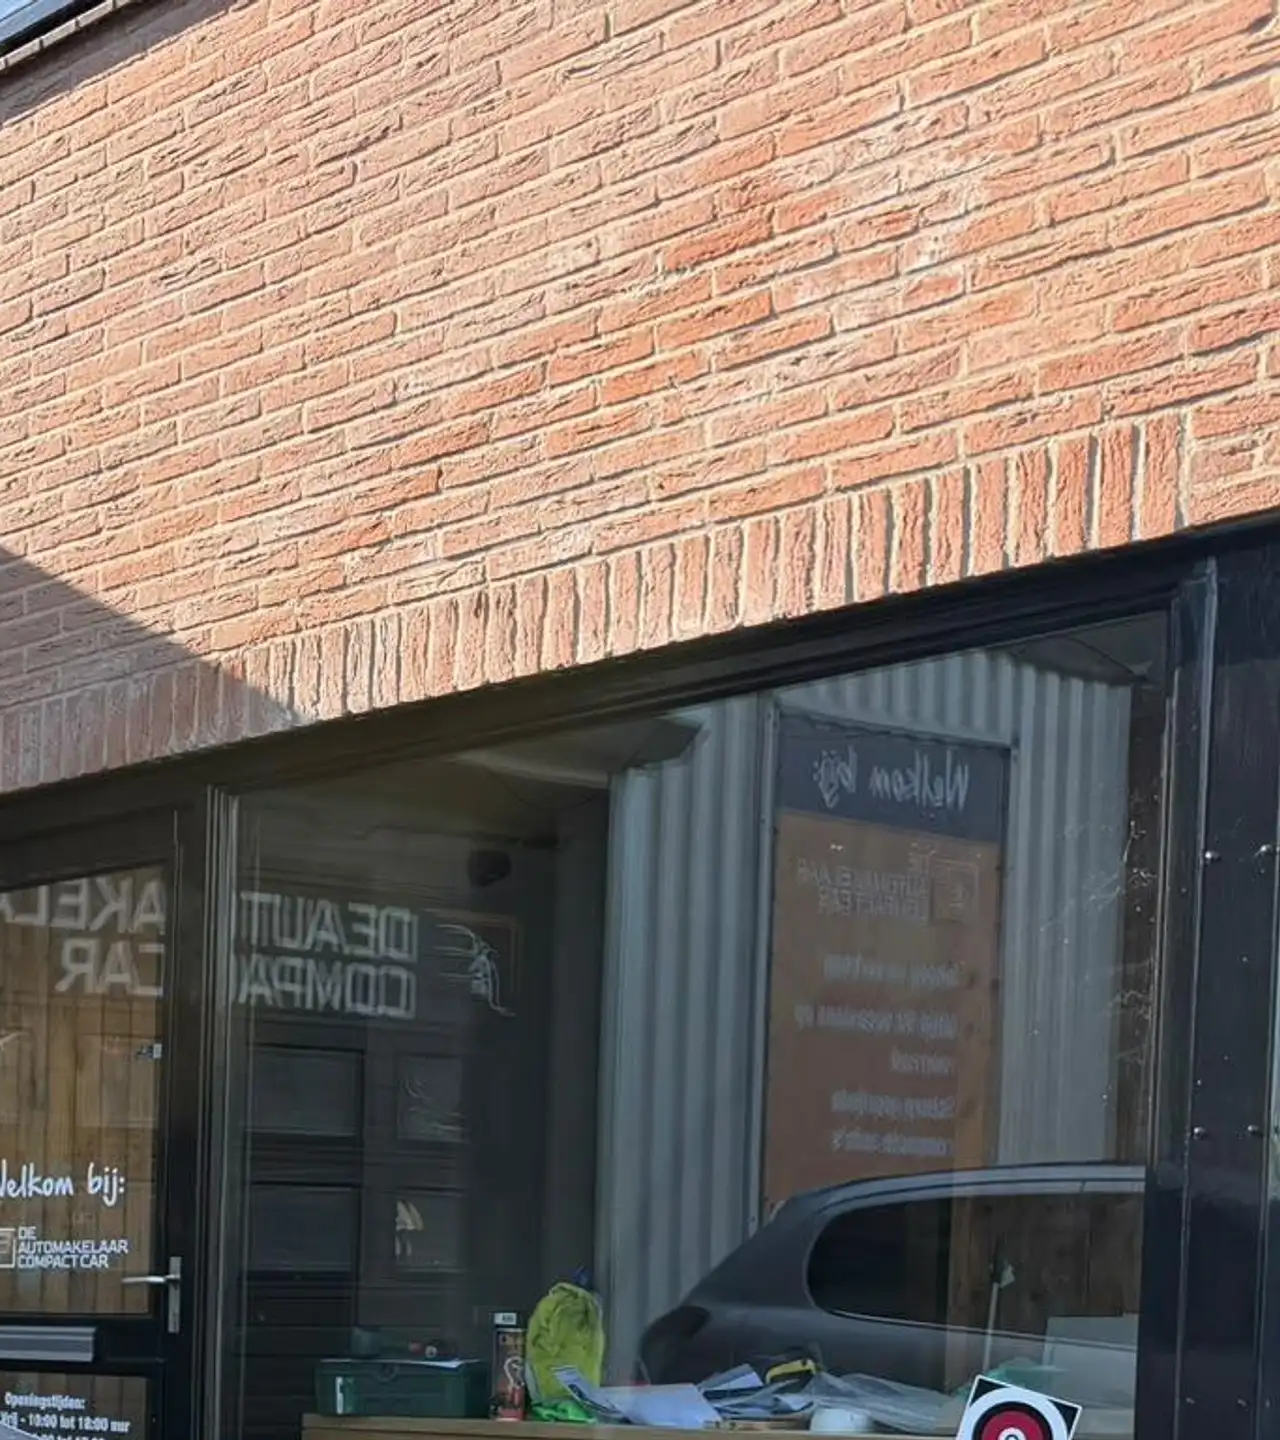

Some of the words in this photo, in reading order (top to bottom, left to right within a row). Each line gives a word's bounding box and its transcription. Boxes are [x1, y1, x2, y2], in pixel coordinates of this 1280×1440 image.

[87, 1161, 126, 1207] bij:
[17, 1225, 37, 1241] DE
[17, 1238, 129, 1256] AUTOMAKELAAR
[17, 1254, 78, 1269] COMPACT
[80, 1254, 109, 1269] CAR
[4, 1391, 86, 1411] Openingstijden:
[59, 1414, 75, 1430] tot
[110, 1420, 131, 1433] uur
